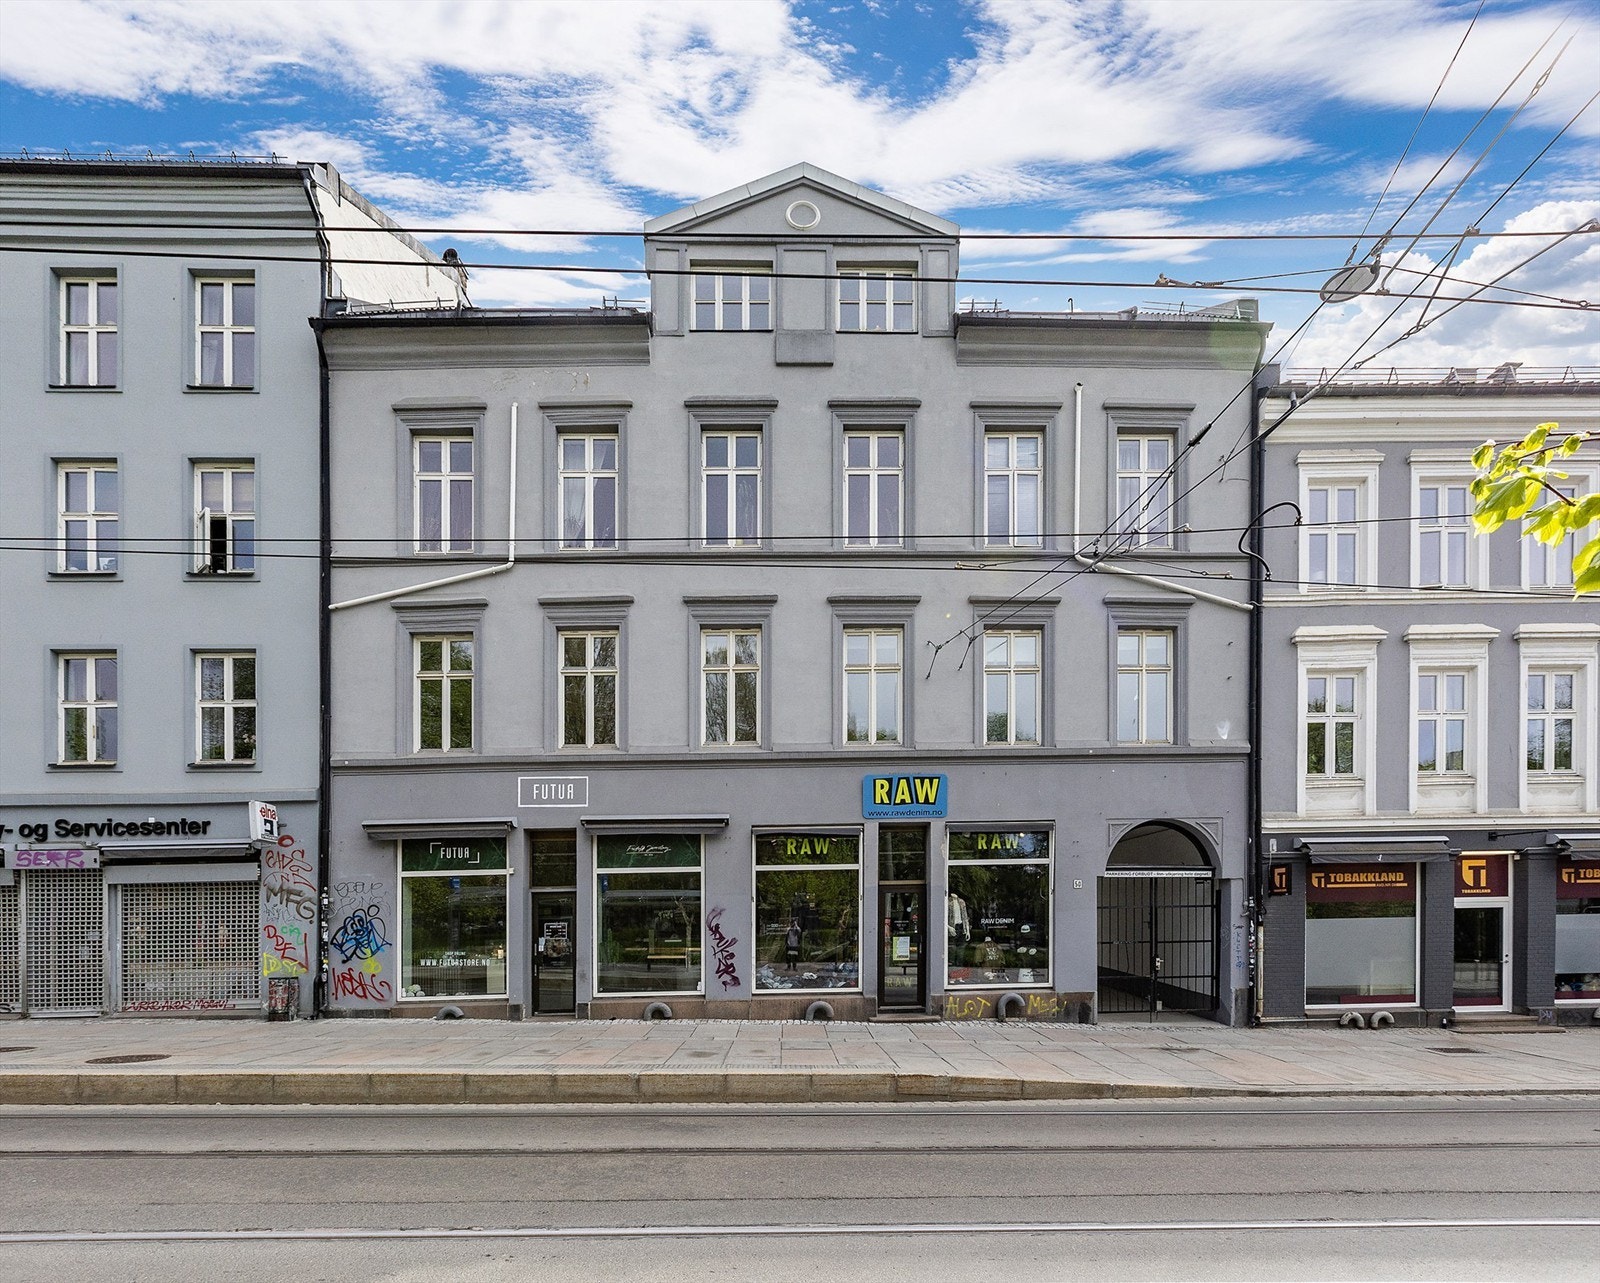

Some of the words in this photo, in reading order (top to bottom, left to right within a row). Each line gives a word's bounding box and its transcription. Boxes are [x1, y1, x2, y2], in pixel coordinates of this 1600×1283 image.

[874, 778, 940, 805] RAW
[18, 823, 48, 842] og
[54, 817, 211, 838] Servicesenter
[786, 837, 830, 855] RAW
[977, 833, 1020, 850] RAW
[1328, 872, 1404, 882] TOBAKKLAND
